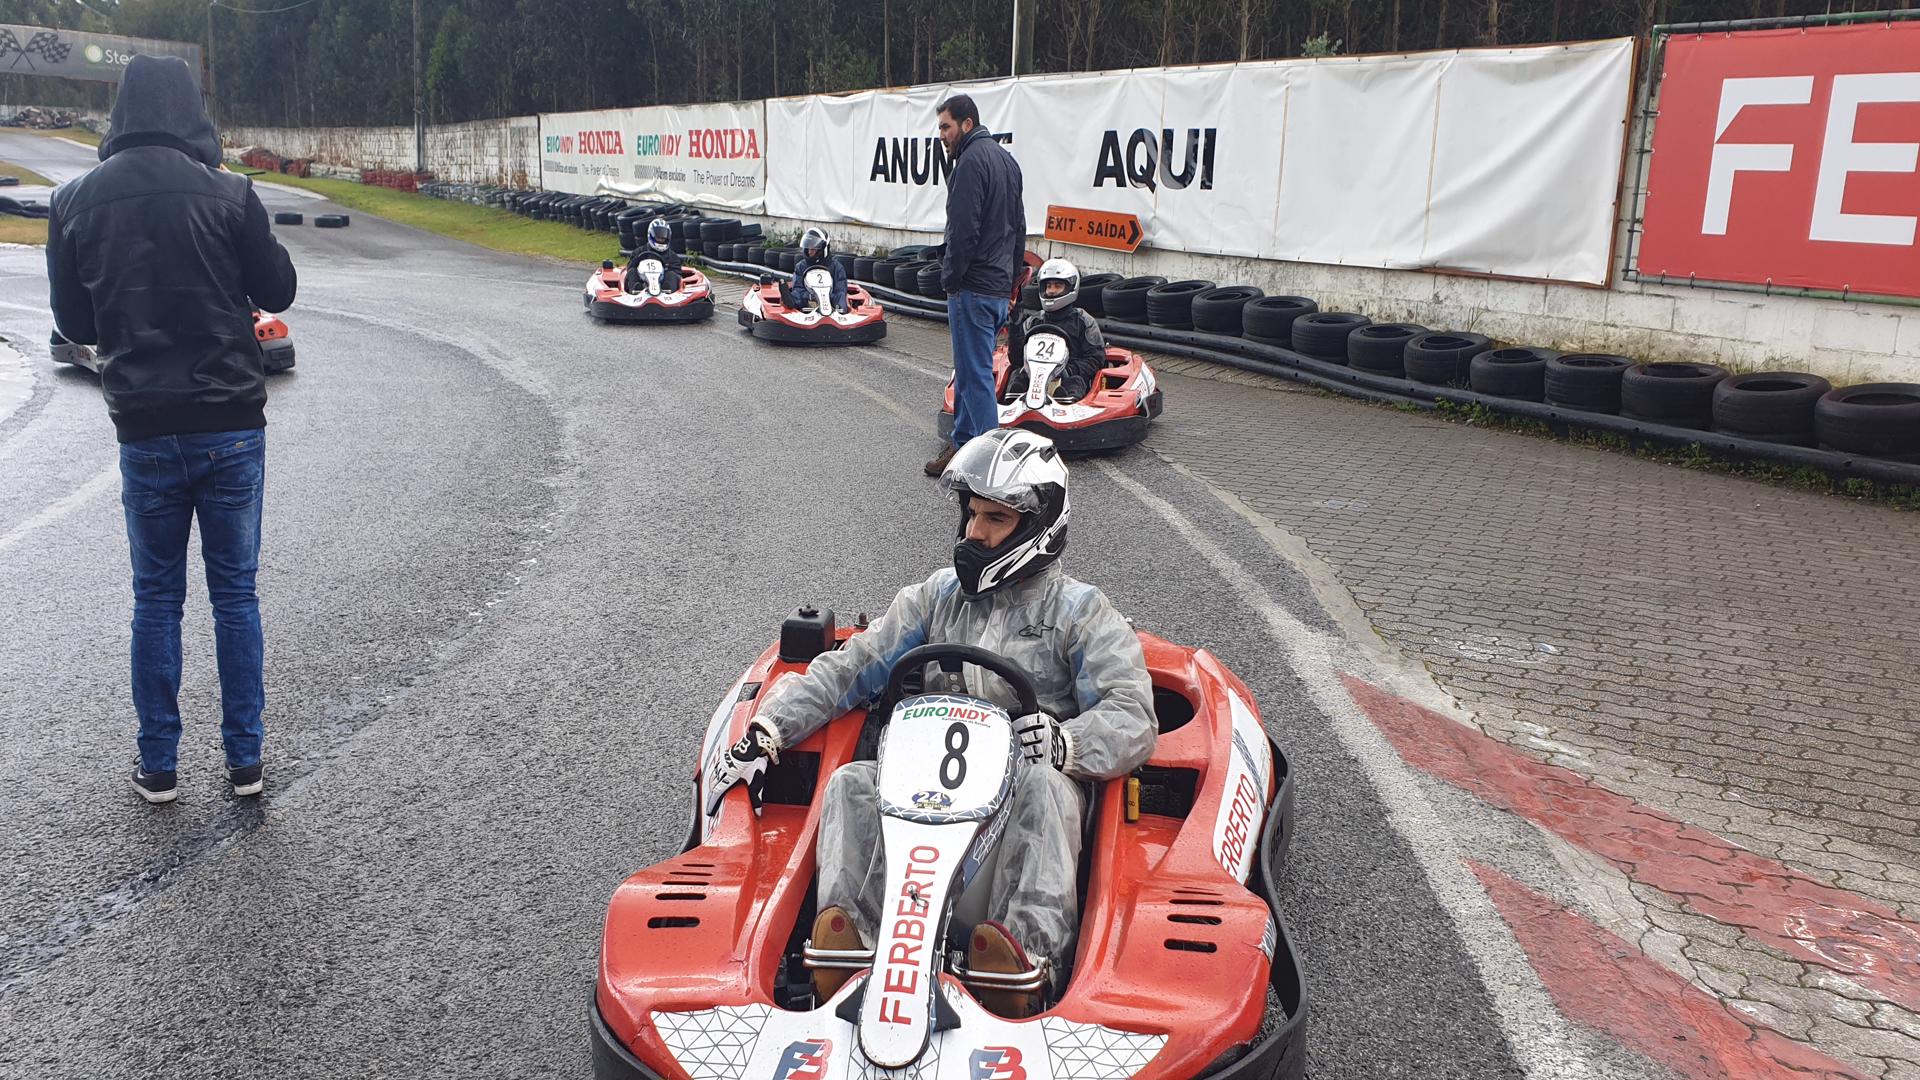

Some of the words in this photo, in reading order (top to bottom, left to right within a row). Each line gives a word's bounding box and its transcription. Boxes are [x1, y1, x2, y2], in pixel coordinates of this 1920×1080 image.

[105, 49, 134, 65] Ste
[578, 130, 624, 155] HONDA
[637, 134, 682, 156] EUROINDY
[688, 128, 760, 159] HONDA
[1093, 128, 1217, 193] AQUI
[1701, 72, 1920, 245] FE
[693, 169, 705, 184] The
[706, 170, 722, 186] Power
[730, 171, 756, 188] Dreams
[1047, 215, 1076, 232] EXIT
[1087, 219, 1126, 239] SAÍDA
[646, 261, 656, 271] 15
[817, 273, 824, 284] 2
[1035, 340, 1055, 357] 24
[902, 706, 992, 722] EUROINDY
[939, 721, 970, 790] 8
[879, 845, 940, 1026] FERBERTO
